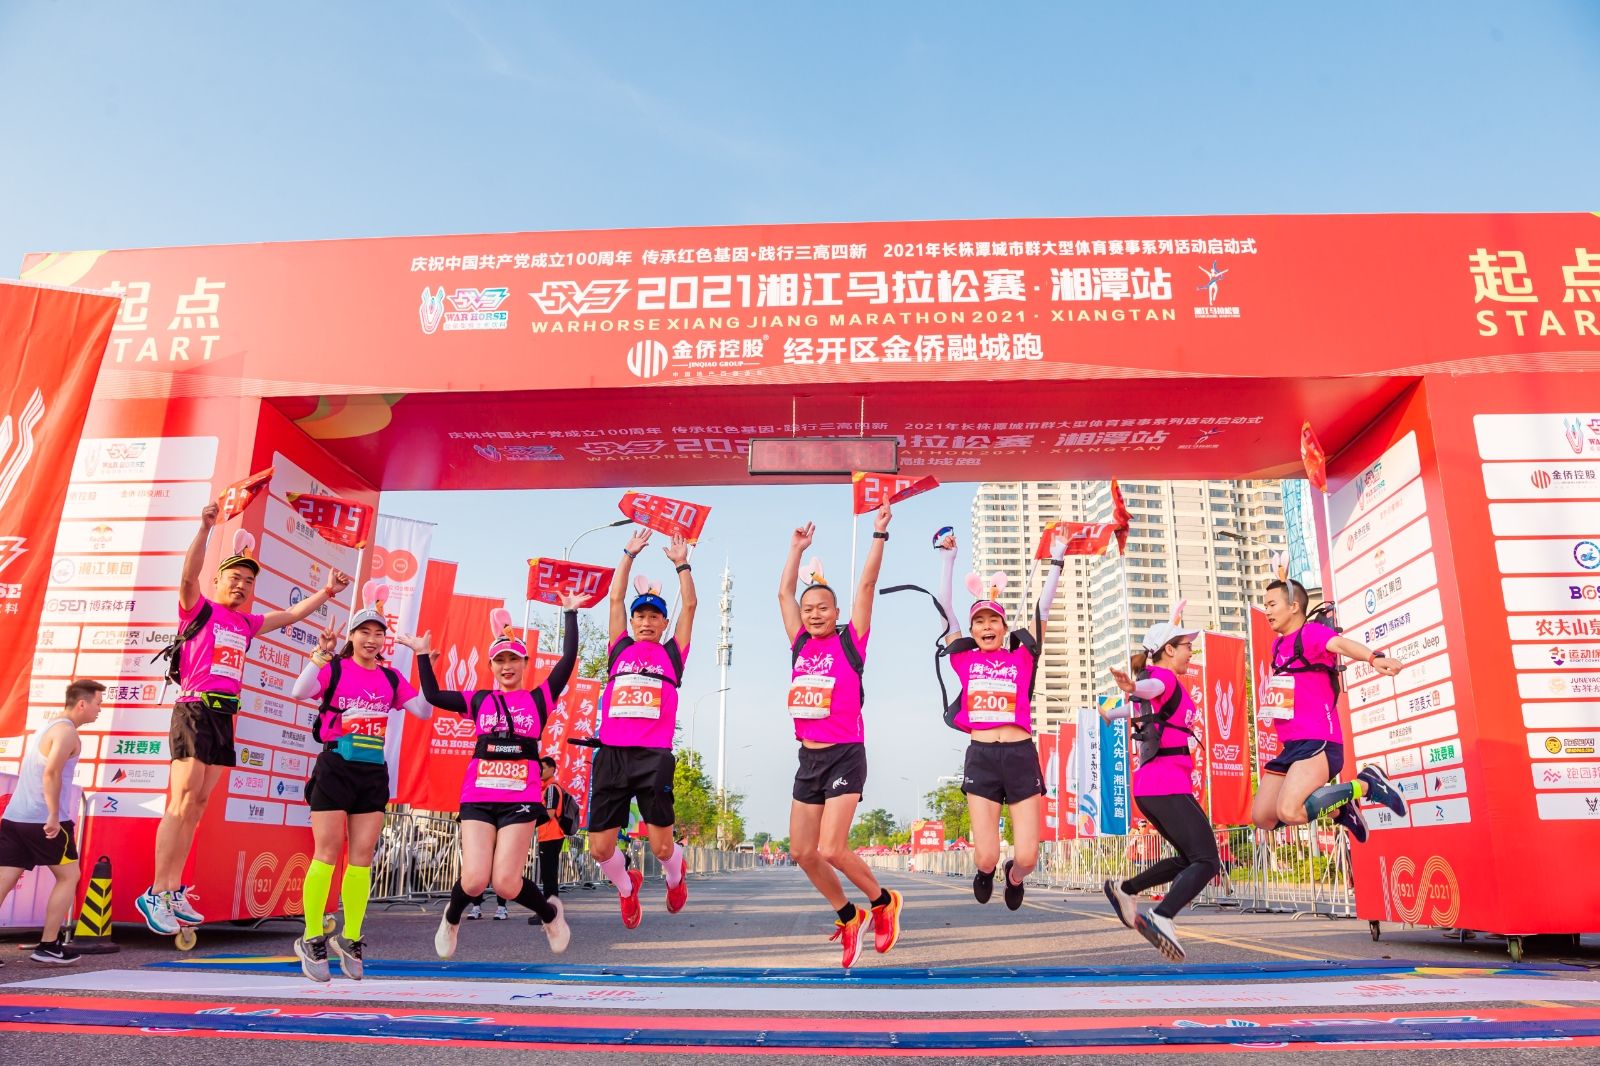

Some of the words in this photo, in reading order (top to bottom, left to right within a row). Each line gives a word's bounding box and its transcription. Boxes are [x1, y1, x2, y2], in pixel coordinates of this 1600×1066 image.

[410, 251, 633, 272] 庆祝中国共产党成立100周年
[642, 243, 867, 266] 传承红色基因·践行三高四新
[883, 238, 1258, 259] 2021年长株潭城市群大型体育赛事系列活动启动式
[532, 319, 660, 334] WARHORSE
[667, 317, 740, 330] XIANG
[747, 315, 820, 329] JIANG
[829, 311, 967, 326] MARATHON
[972, 310, 1027, 323] 2021
[1051, 309, 1177, 322] XIANGTAN
[1476, 309, 1600, 336] STAR
[113, 335, 220, 362] TART
[671, 338, 764, 360] 金侨控股
[783, 333, 1043, 366] 经开区金侨融城跑
[448, 427, 662, 439] 庆祝中国共产党成立100周年
[1552, 470, 1596, 480] 金侨控股
[298, 499, 363, 532] 2:15
[632, 494, 698, 528] 2:30
[79, 562, 133, 575] 湘江集团
[538, 563, 603, 594] 2:30
[89, 600, 136, 612] 博森体育
[1422, 635, 1440, 650] Jeep
[258, 644, 290, 668] 农夫山泉
[617, 690, 653, 705] 2:30
[792, 691, 823, 706] 2:00
[973, 695, 1008, 710] 2:00
[350, 722, 381, 736] 2:15
[480, 760, 528, 779] C20383
[286, 878, 304, 892] 202
[1397, 883, 1415, 898] 1921
[1429, 884, 1450, 900] 2021
